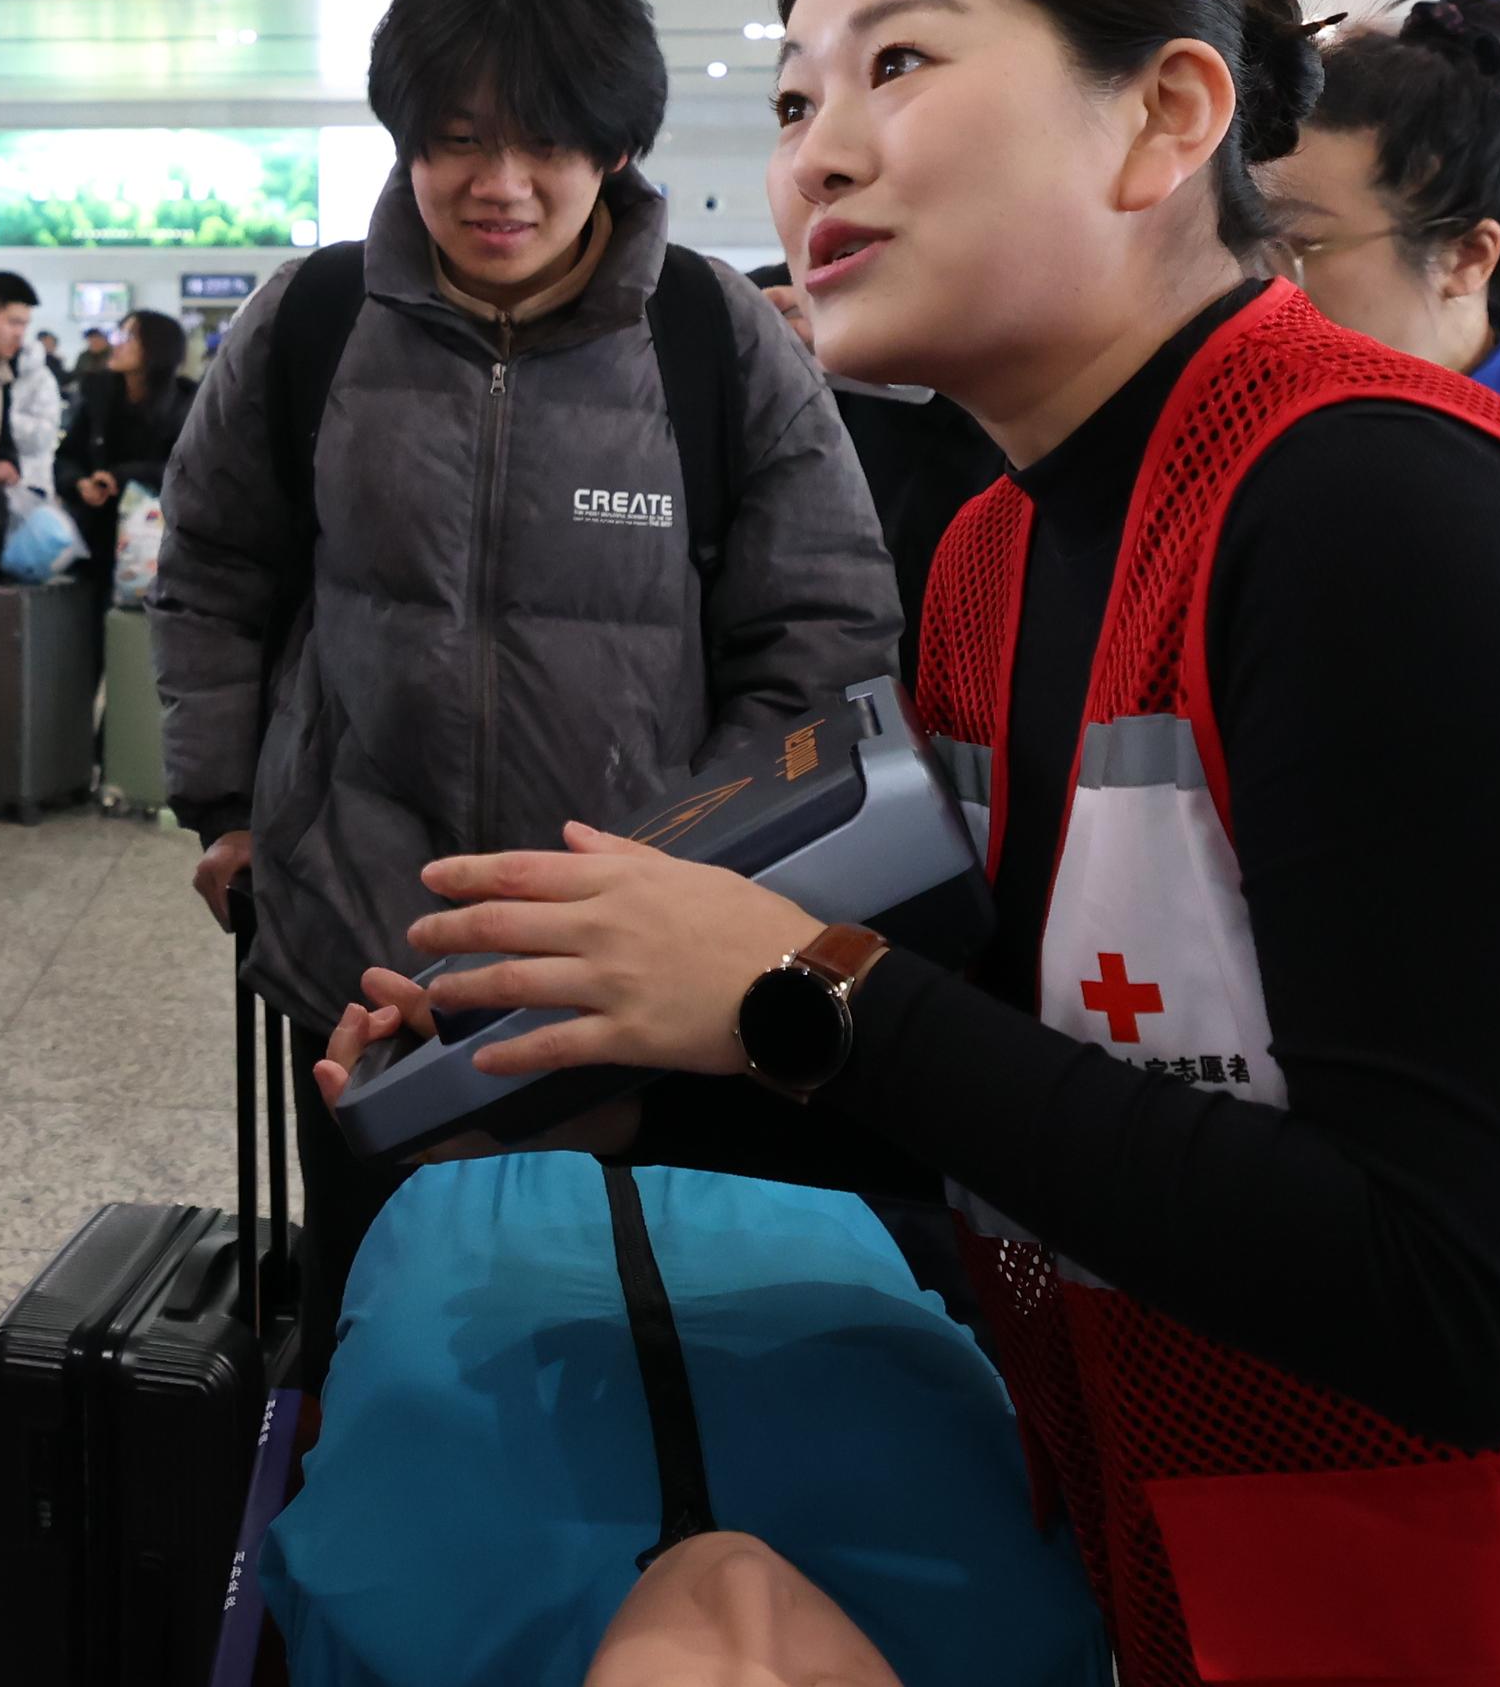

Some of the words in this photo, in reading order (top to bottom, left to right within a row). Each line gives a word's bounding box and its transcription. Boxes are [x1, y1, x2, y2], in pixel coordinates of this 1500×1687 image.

[573, 488, 673, 516] CREATE
[1125, 1053, 1251, 1085] 志愿者
